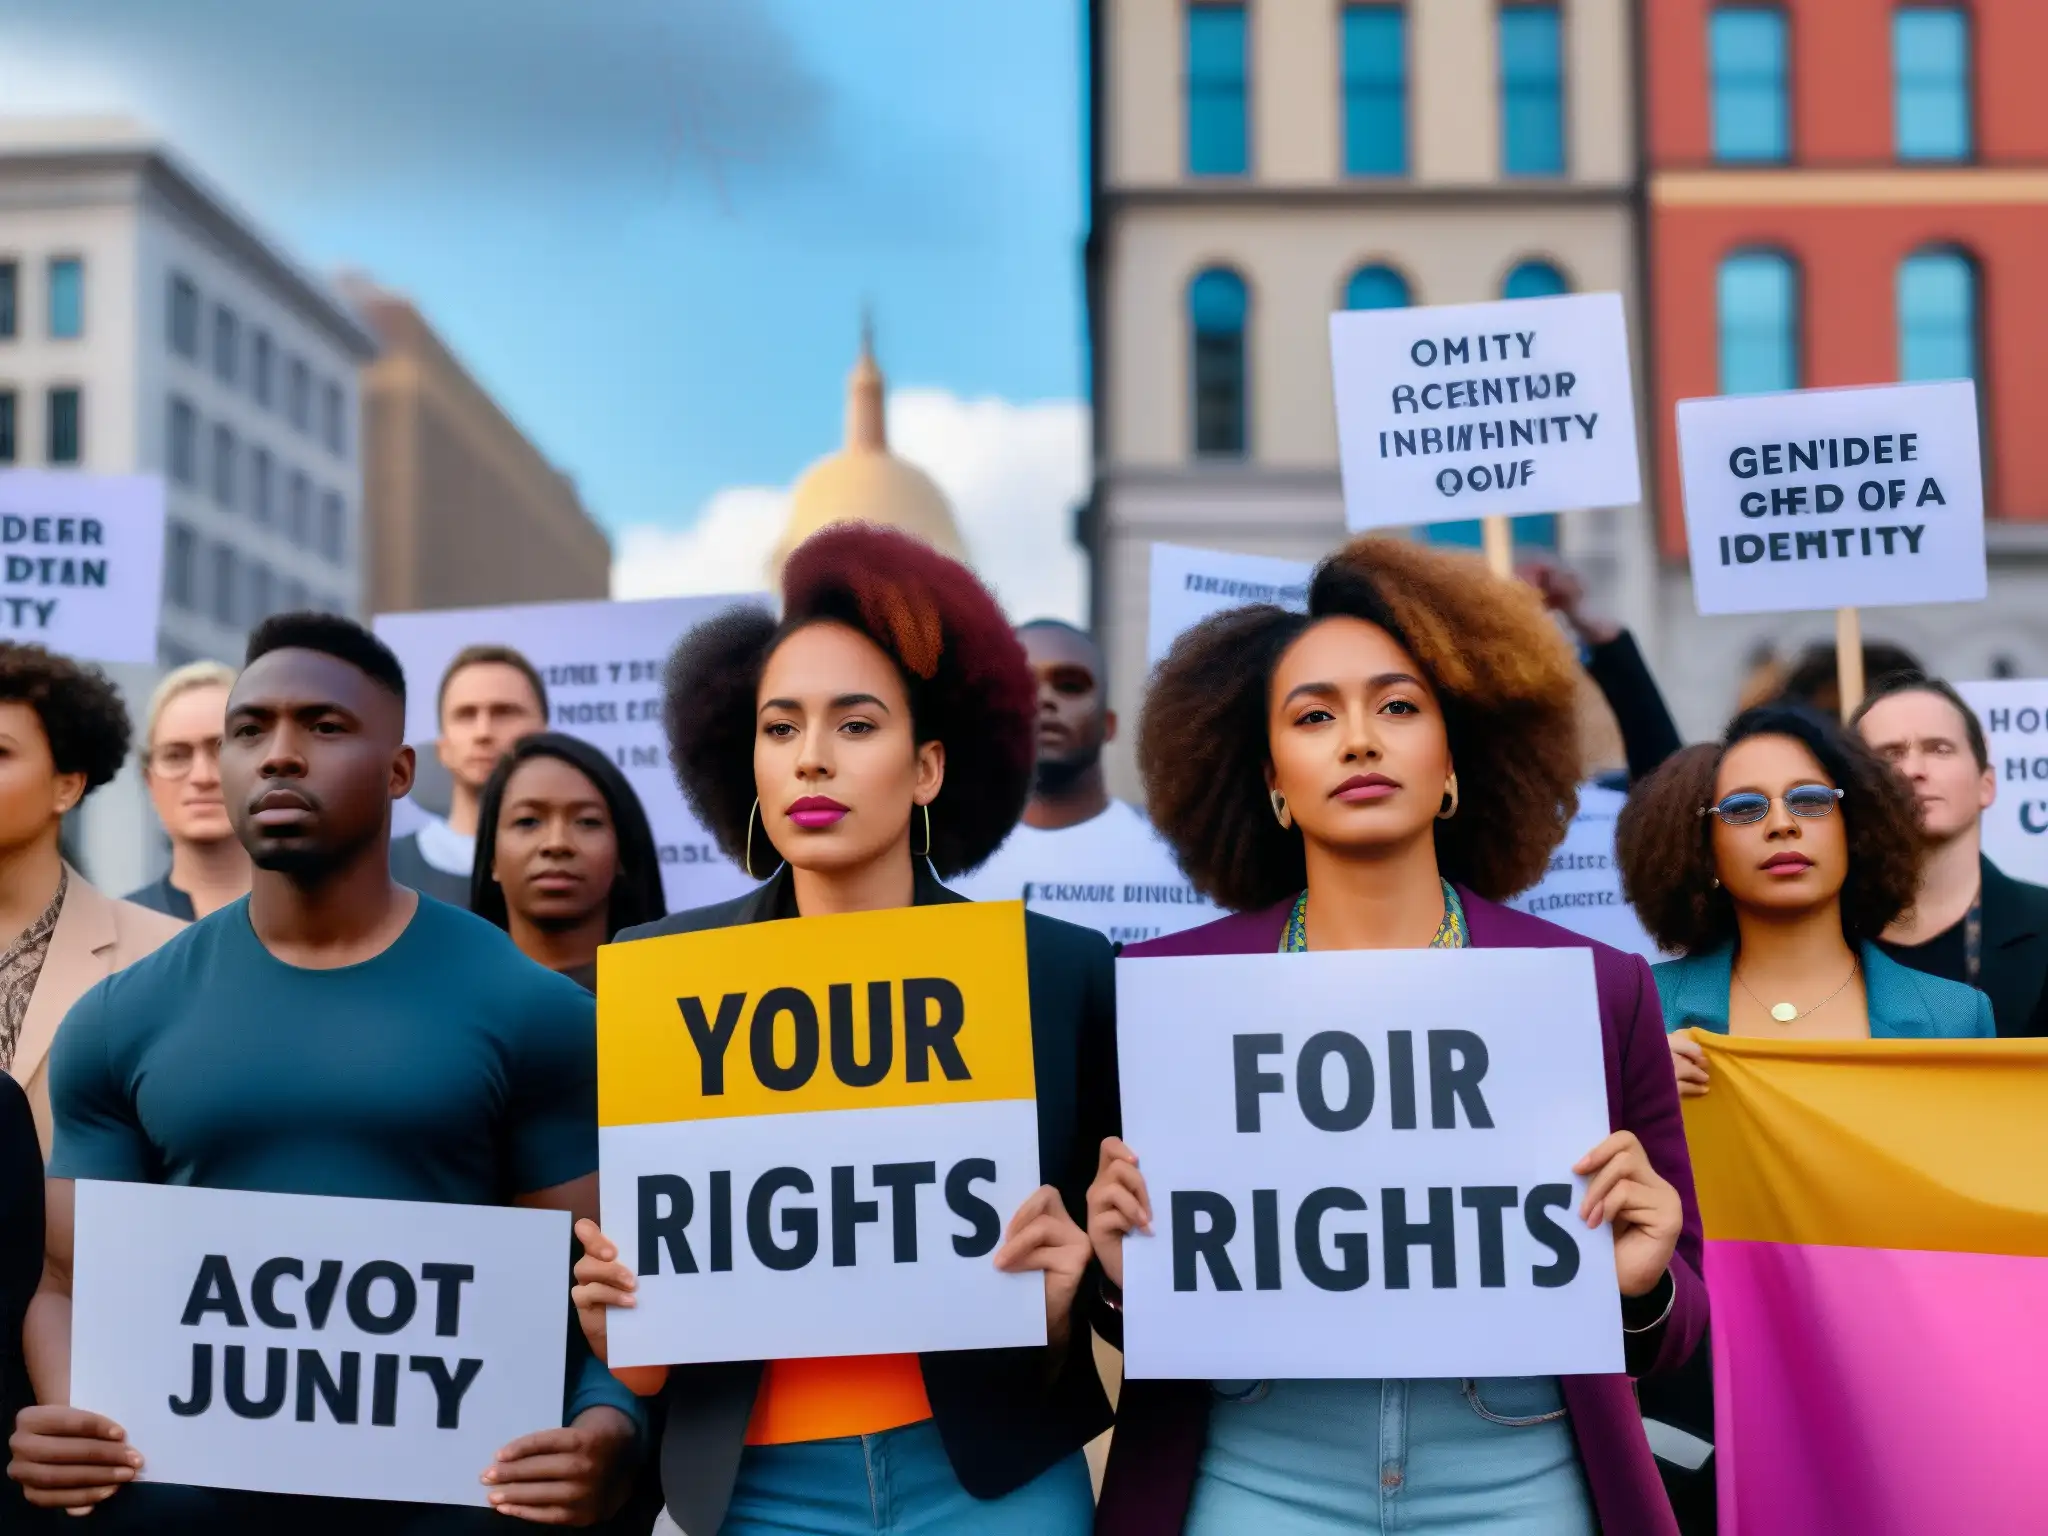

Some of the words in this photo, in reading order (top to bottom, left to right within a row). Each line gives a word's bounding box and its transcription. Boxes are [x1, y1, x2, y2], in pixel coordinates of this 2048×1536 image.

[1410, 331, 1536, 367] OMITY
[1916, 477, 1946, 507] A
[677, 977, 973, 1096] YOUR
[1232, 1029, 1496, 1133] FOIR
[637, 1157, 1002, 1277] RIGHTS
[1171, 1183, 1581, 1292] RIGHTS
